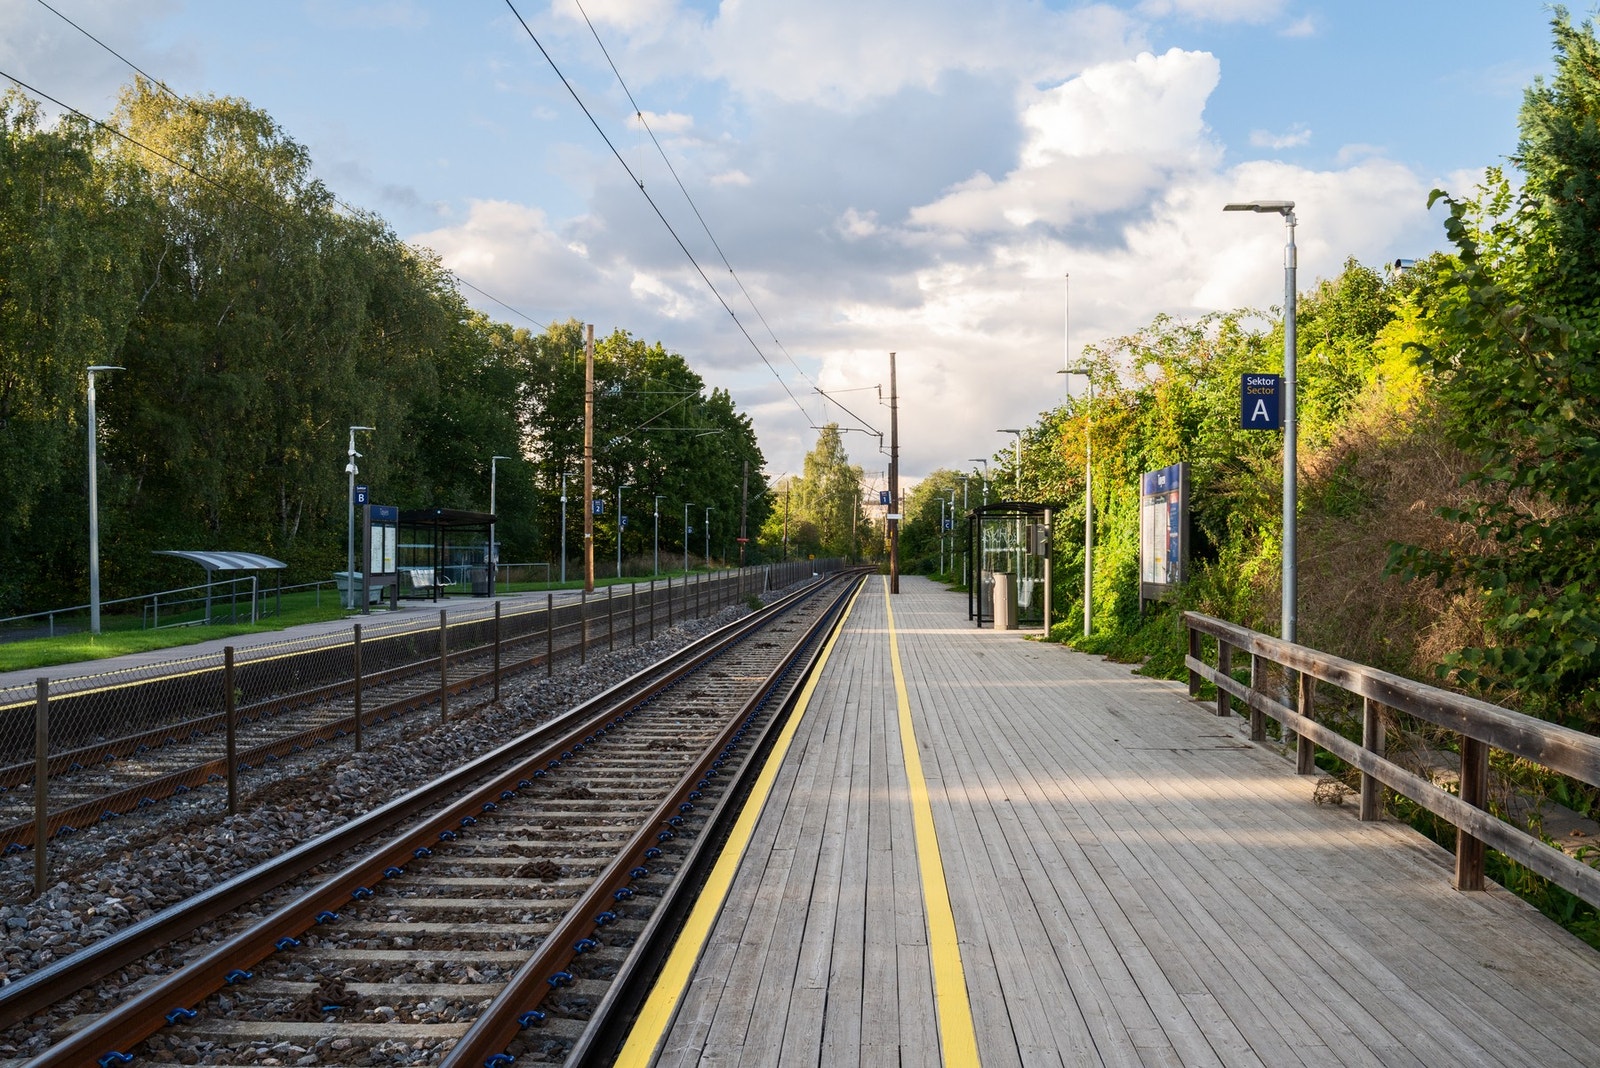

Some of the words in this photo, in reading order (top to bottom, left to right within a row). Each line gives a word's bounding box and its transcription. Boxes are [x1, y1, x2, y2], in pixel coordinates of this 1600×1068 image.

[1247, 376, 1274, 386] Sektor
[1247, 386, 1274, 394] Sector
[1251, 399, 1270, 421] A
[358, 494, 364, 502] B
